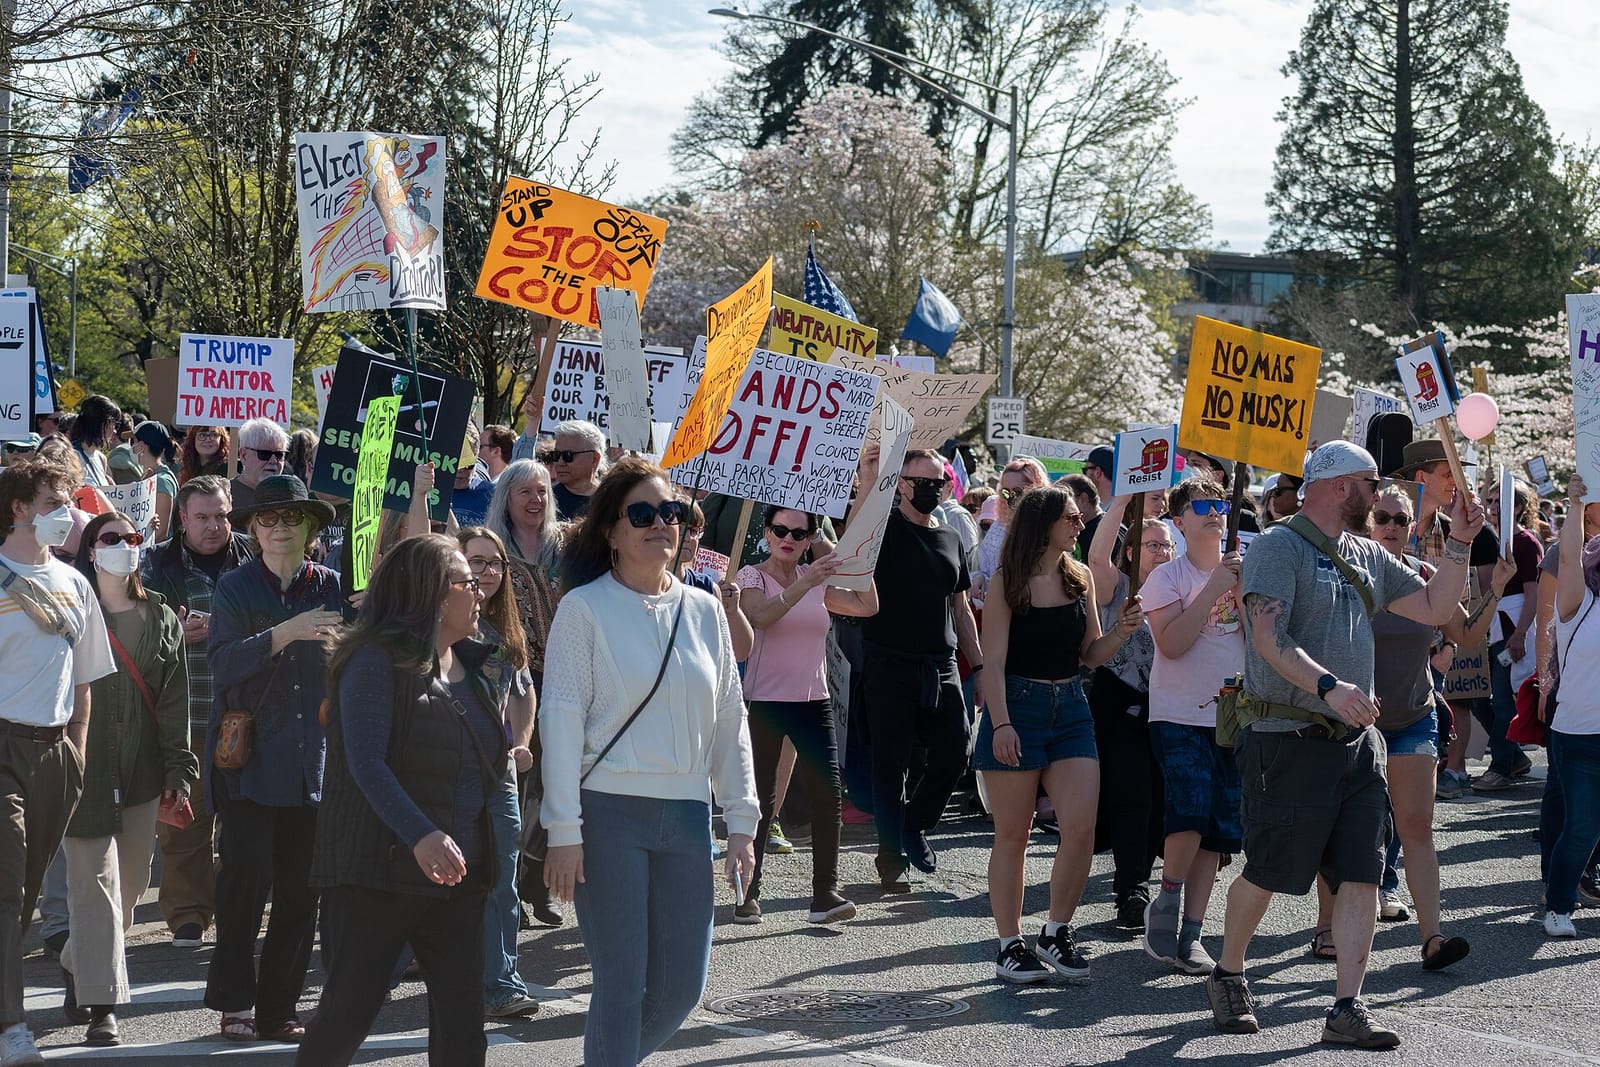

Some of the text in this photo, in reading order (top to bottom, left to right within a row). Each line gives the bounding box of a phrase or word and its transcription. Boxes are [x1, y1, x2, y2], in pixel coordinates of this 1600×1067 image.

[298, 141, 364, 189] EVICT
[501, 185, 551, 212] STAND
[506, 199, 553, 228] UP
[593, 218, 653, 269] OUT
[607, 208, 661, 262] SPEAK
[502, 226, 632, 281] STOP
[541, 265, 586, 289] THE
[0, 327, 24, 339] PLE
[188, 339, 272, 366] TRUMP
[788, 337, 818, 361] IS
[1212, 338, 1296, 383] NO MAS
[186, 368, 275, 392] TRAITOR
[553, 371, 584, 388] OUR
[646, 360, 674, 383] FF
[755, 352, 823, 381] SECURITY
[832, 370, 873, 390] SCHOOL
[739, 371, 845, 419] ANDS
[884, 373, 910, 388] THE
[912, 379, 980, 397] STEAL
[180, 394, 287, 423] TO AMERICA
[551, 389, 583, 405] OUR
[845, 389, 875, 408] NATO
[991, 402, 1022, 411] SPEED
[1417, 397, 1440, 413] Resist
[548, 406, 577, 422] OUR
[838, 410, 870, 428] FREE
[924, 405, 960, 418] OFF
[994, 412, 1018, 420] LIMIT
[1201, 385, 1306, 440] NO MUSK!
[824, 422, 866, 440] SPEECH
[992, 422, 1020, 439] 25
[324, 428, 362, 451] SEN
[394, 442, 458, 474] MUSK
[815, 443, 860, 462] COURTS
[1020, 440, 1064, 458] HANDS
[733, 463, 776, 486] PARKS
[810, 462, 854, 484] WOMEN
[1128, 472, 1162, 485] Resist
[385, 478, 440, 506] MAS
[728, 479, 787, 505] RESEARCH
[795, 495, 828, 513] AIR
[131, 499, 150, 521] eggs
[1446, 674, 1489, 694] udents
